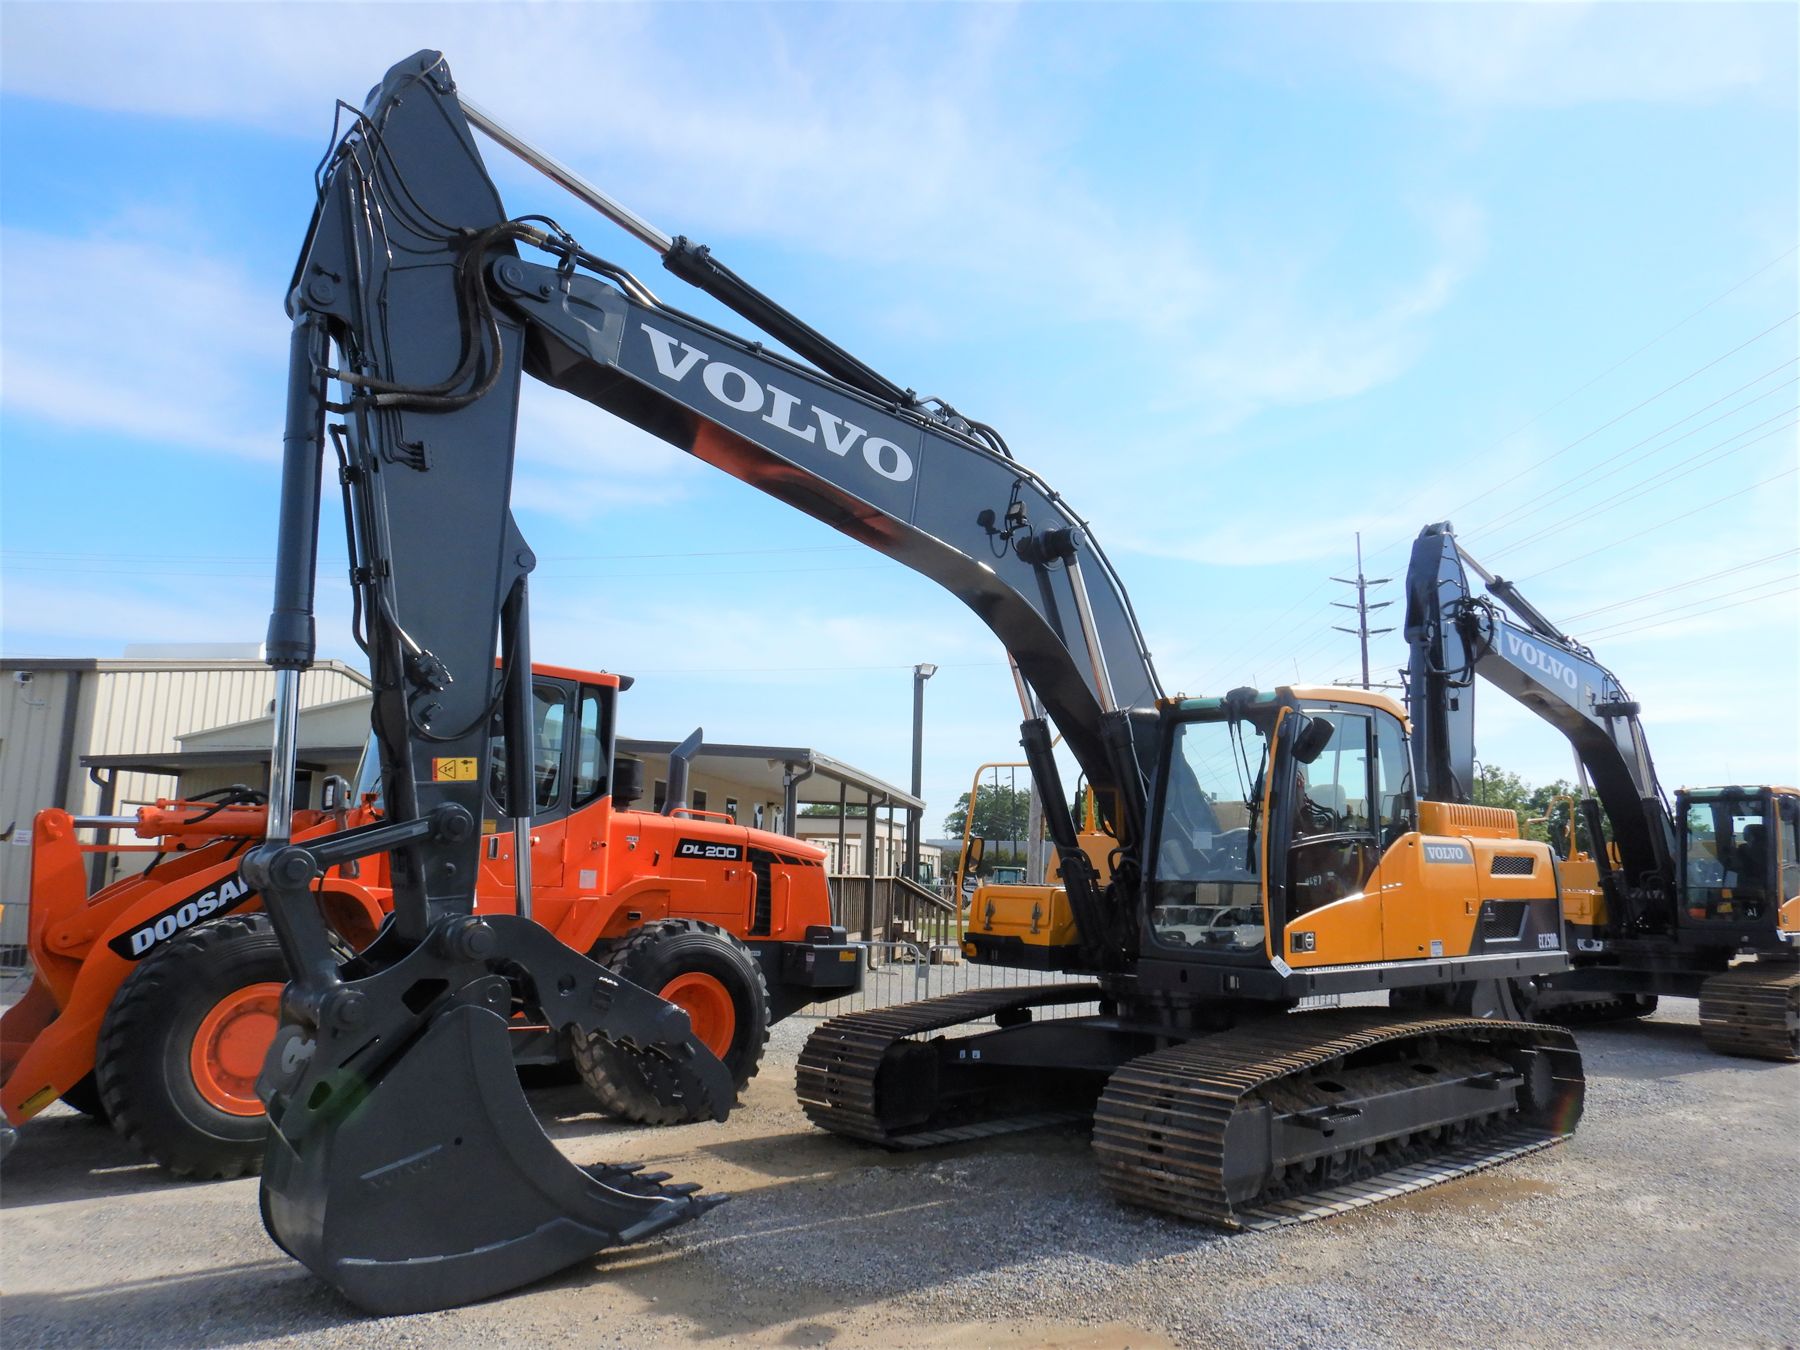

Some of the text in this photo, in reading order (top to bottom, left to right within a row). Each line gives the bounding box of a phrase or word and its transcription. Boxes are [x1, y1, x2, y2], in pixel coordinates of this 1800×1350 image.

[640, 323, 913, 482] VOLVO
[1505, 631, 1578, 689] VOLVO
[1426, 845, 1464, 861] VOLVO
